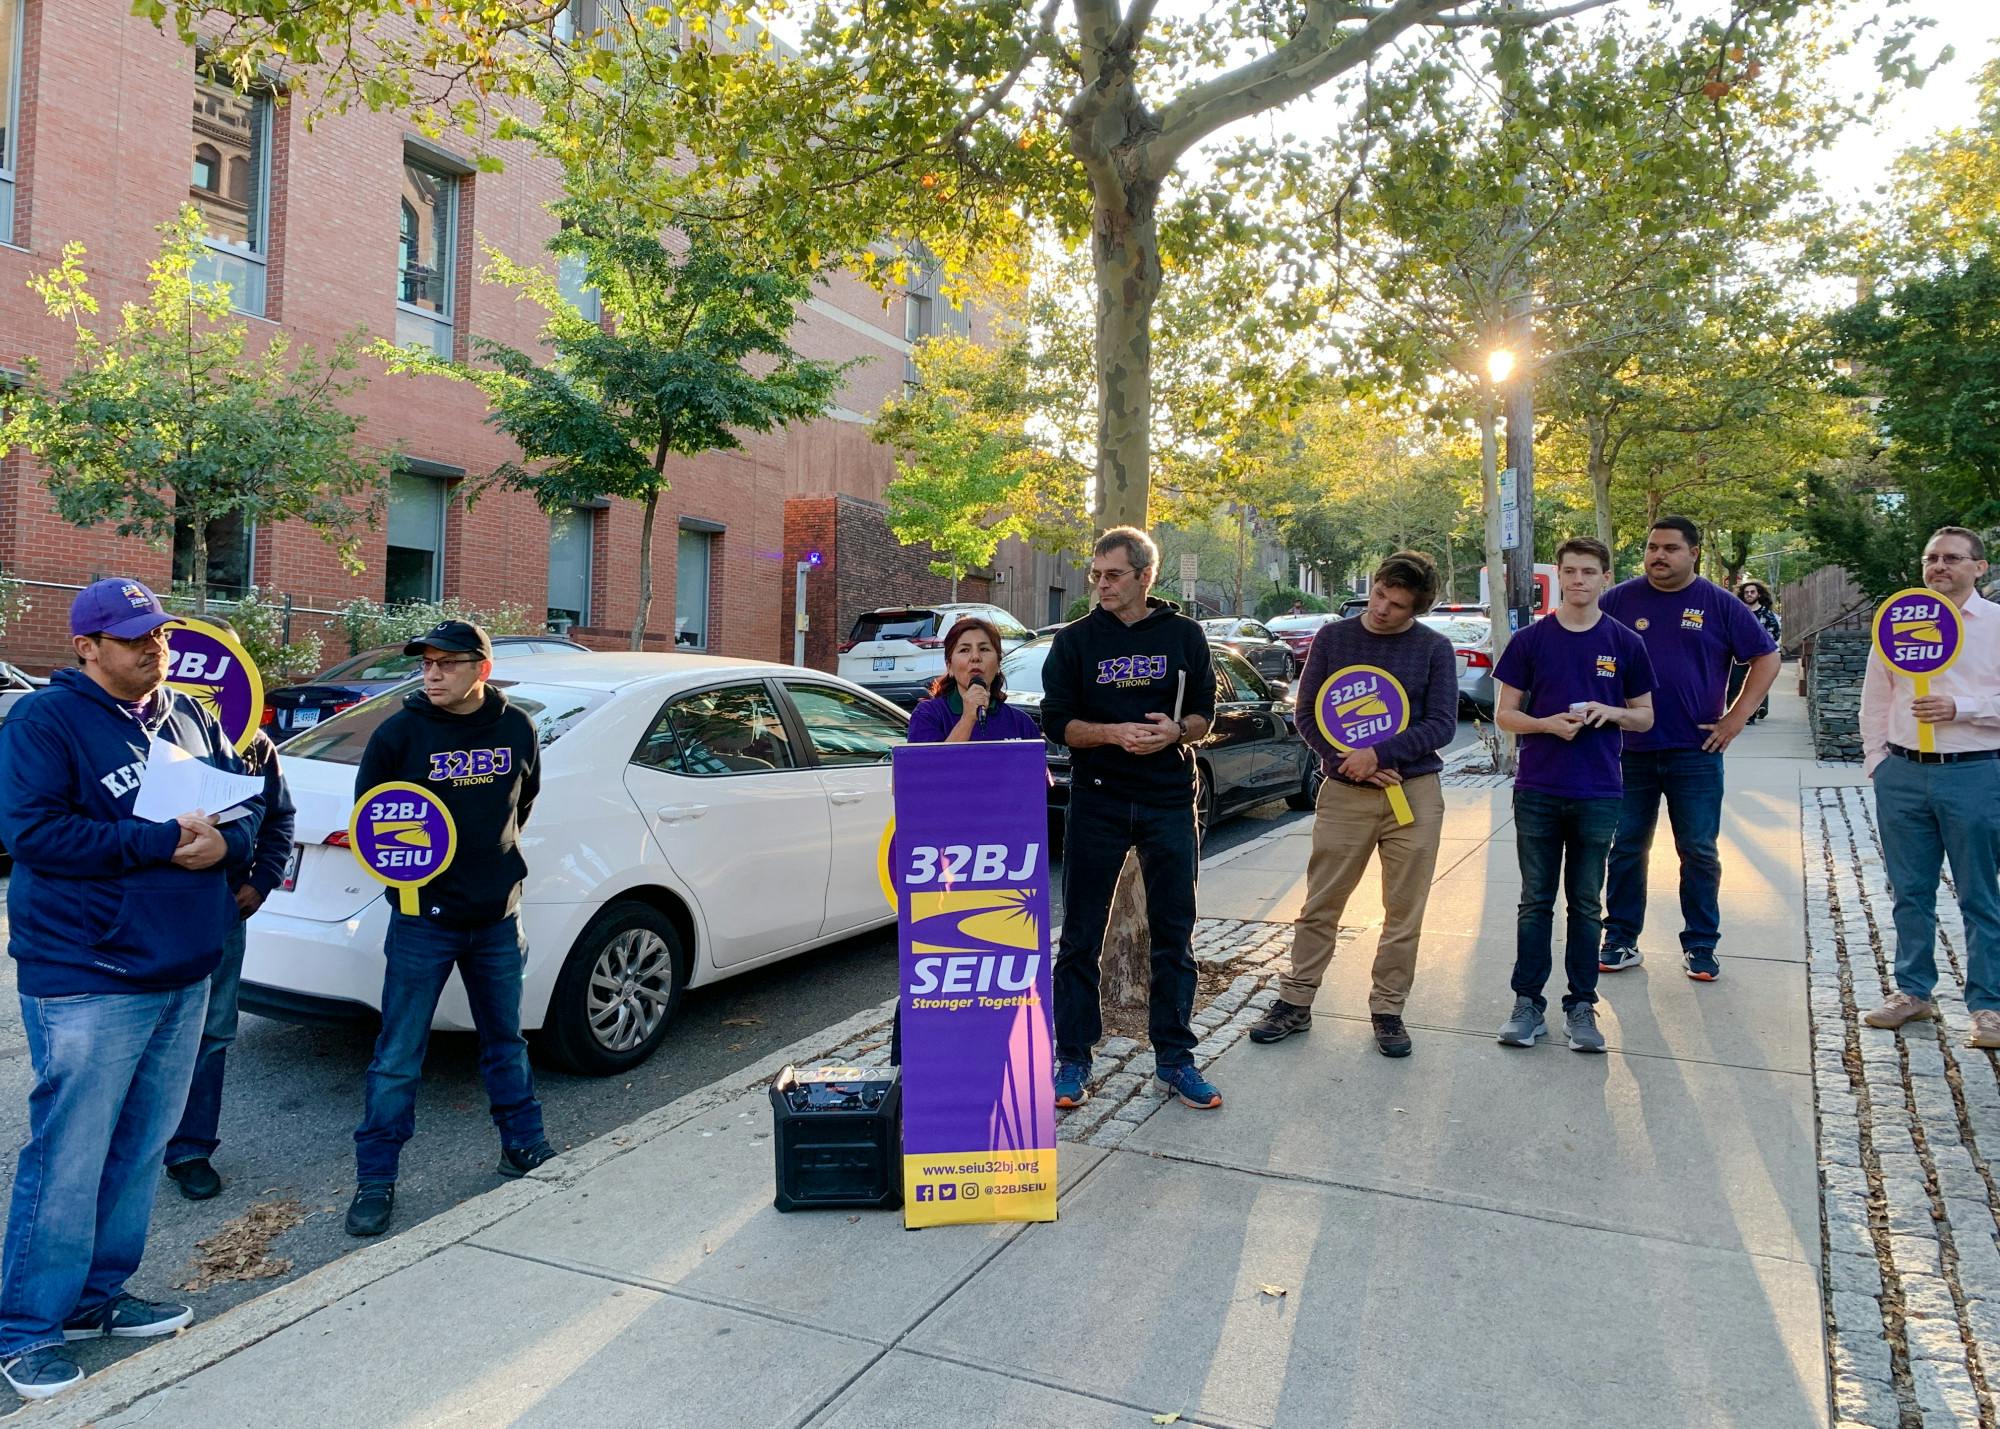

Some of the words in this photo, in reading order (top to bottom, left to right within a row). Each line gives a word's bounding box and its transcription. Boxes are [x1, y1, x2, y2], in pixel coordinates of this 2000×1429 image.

[1683, 608, 1704, 616] 32BJ
[1890, 604, 1940, 622] 32BJ
[1681, 620, 1703, 629] SEIU
[1596, 655, 1617, 663] 32BJ
[1894, 645, 1943, 661] SEIU
[168, 649, 231, 681] 2BJ
[1096, 655, 1167, 684] 32BJ
[1115, 679, 1151, 688] STRONG
[1330, 676, 1378, 706] 32BJ
[1345, 714, 1393, 743] SEIU
[428, 747, 512, 781] 32BJ
[452, 776, 494, 787] STRONG
[369, 802, 428, 820] 32BJ
[375, 849, 433, 868] SEIU
[905, 843, 1040, 884] 32BJ
[909, 954, 1041, 995] SEIU
[911, 997, 973, 1012] Stronger
[977, 994, 1042, 1011] Together
[922, 1160, 1040, 1177] www.seiu32bj.org
[984, 1182, 1048, 1196] @32BJSEIU
